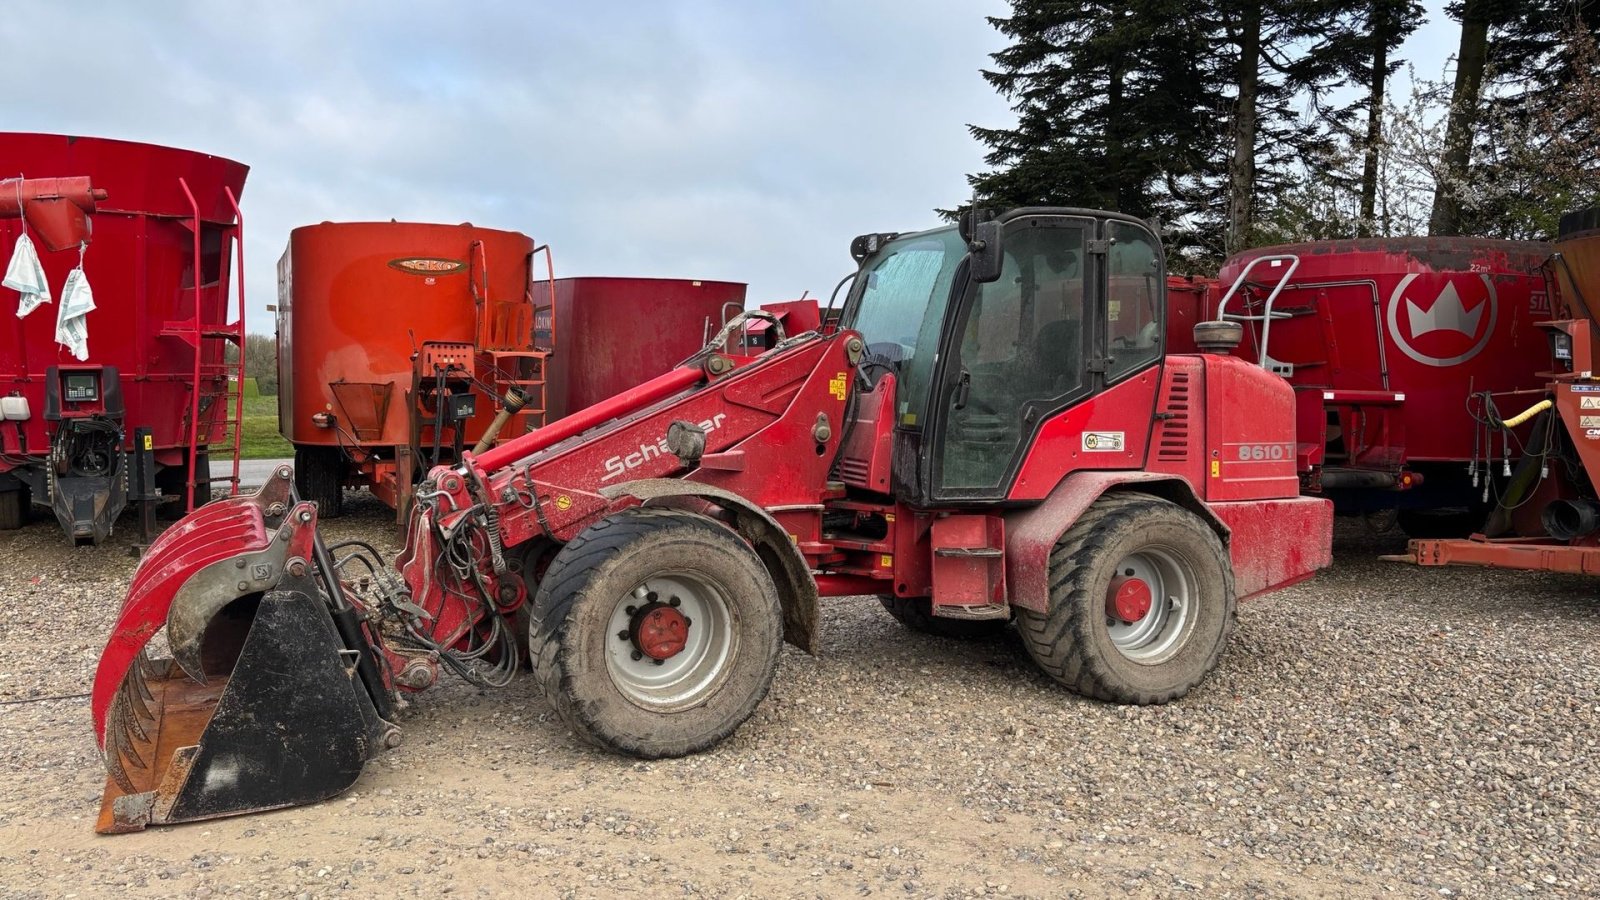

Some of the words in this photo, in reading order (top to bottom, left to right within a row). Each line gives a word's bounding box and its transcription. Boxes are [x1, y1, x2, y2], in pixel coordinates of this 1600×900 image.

[1529, 295, 1550, 310] SIL
[601, 413, 727, 481] Schäer
[1238, 445, 1283, 461] 8610
[1285, 445, 1294, 459] T
